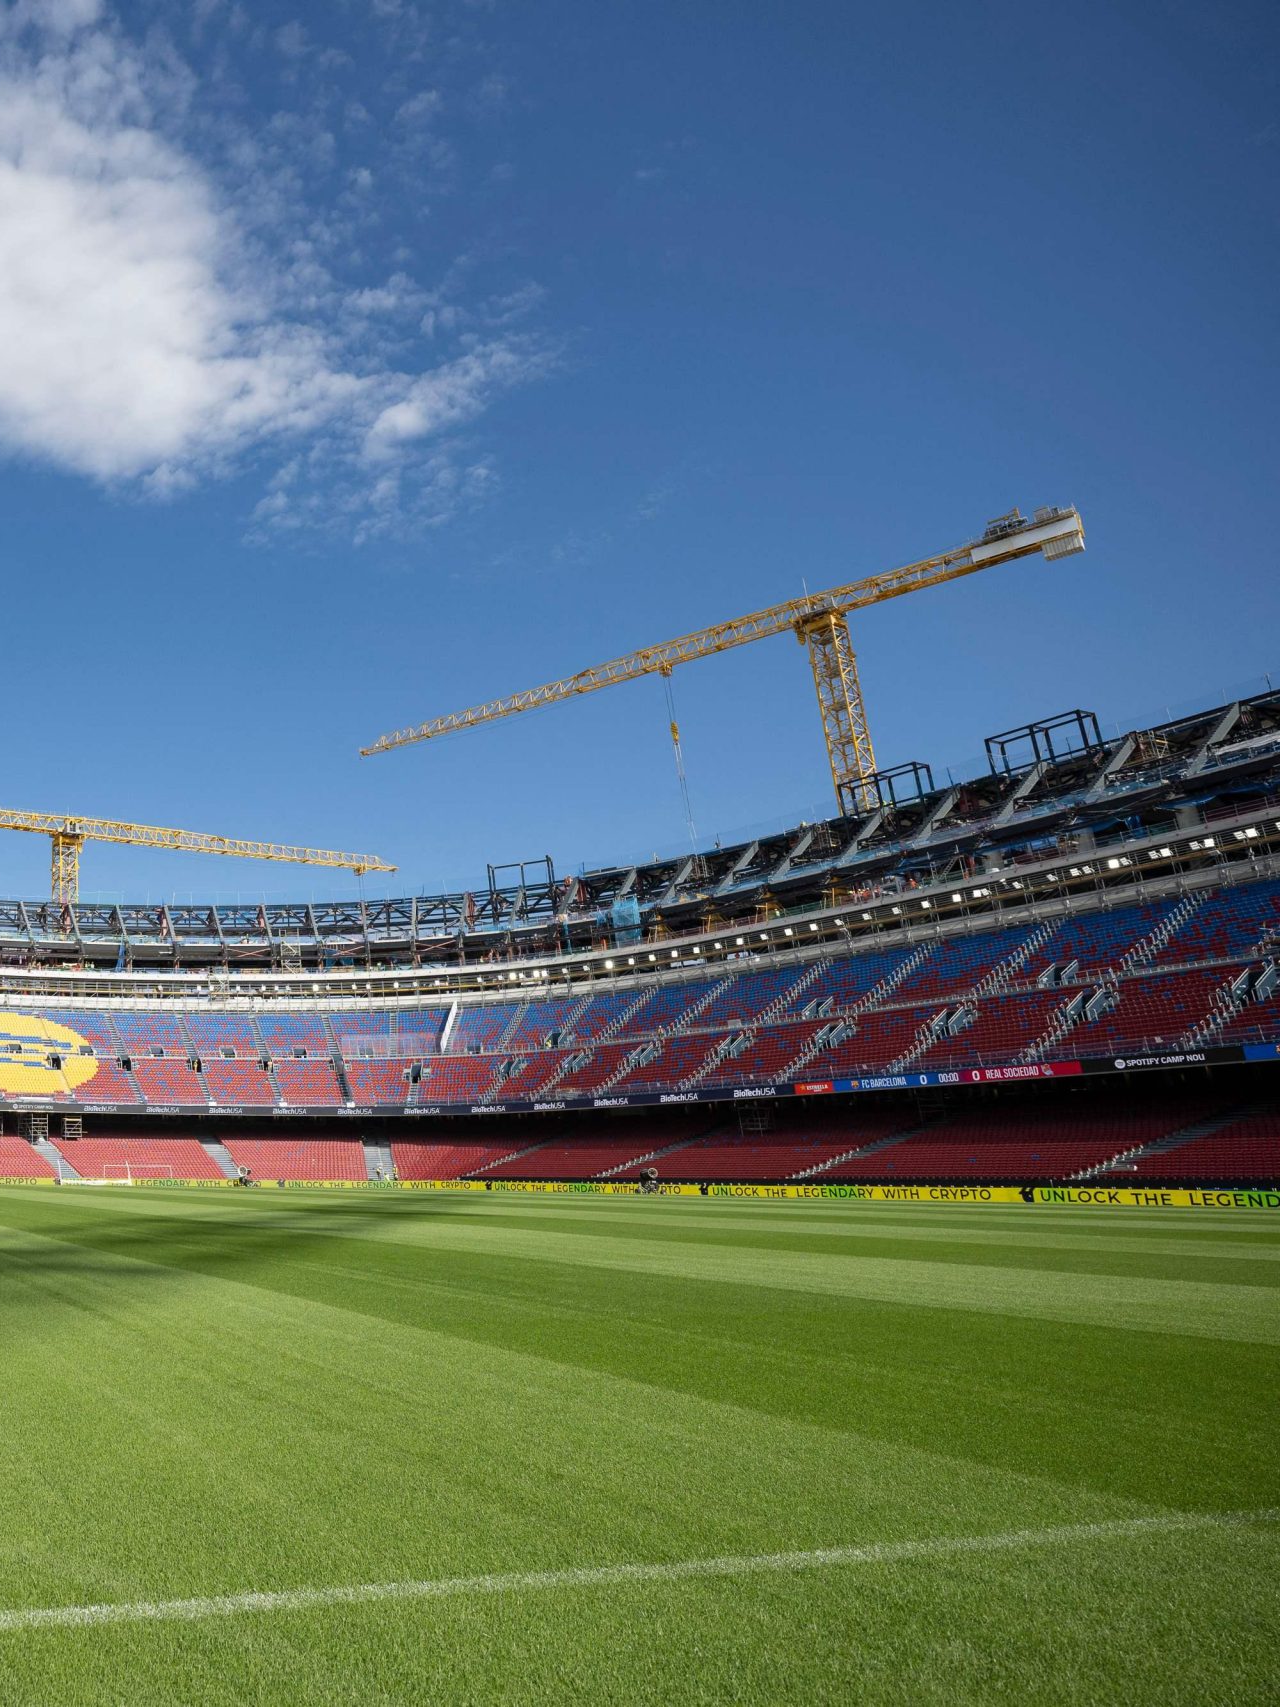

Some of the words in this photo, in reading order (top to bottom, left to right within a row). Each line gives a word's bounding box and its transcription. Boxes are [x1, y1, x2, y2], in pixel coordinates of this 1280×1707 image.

[1126, 1057, 1159, 1067] SPOTIFY
[1160, 1055, 1185, 1064] CAMP
[1186, 1053, 1206, 1062] NOU
[861, 1079, 870, 1088] FC
[870, 1076, 907, 1088] BARCELONA
[920, 1074, 928, 1085] 0
[938, 1072, 959, 1083] 00:00
[972, 1070, 980, 1081] 0
[985, 1068, 1002, 1079] REAL
[1003, 1065, 1040, 1078] SOCIEDAD
[135, 1179, 191, 1187] LEGENDARY
[288, 1181, 324, 1189] UNLOCK
[351, 1181, 405, 1190] LEGENDARY
[410, 1181, 436, 1189] WITH
[440, 1181, 471, 1190] CRYPTO
[494, 1183, 527, 1191] UNLOCK
[531, 1184, 546, 1192] THE
[552, 1184, 606, 1193] LEGENDARY
[611, 1185, 635, 1194] WITH
[712, 1186, 759, 1196] UNLOCK
[764, 1188, 787, 1197] THE
[796, 1187, 874, 1199] LEGENDARY
[882, 1188, 920, 1199] WITH
[929, 1188, 991, 1200] CRYPTO
[1039, 1190, 1121, 1204] UNLOCK
[1130, 1192, 1173, 1206] THE
[1189, 1192, 1280, 1208] LEGEND
